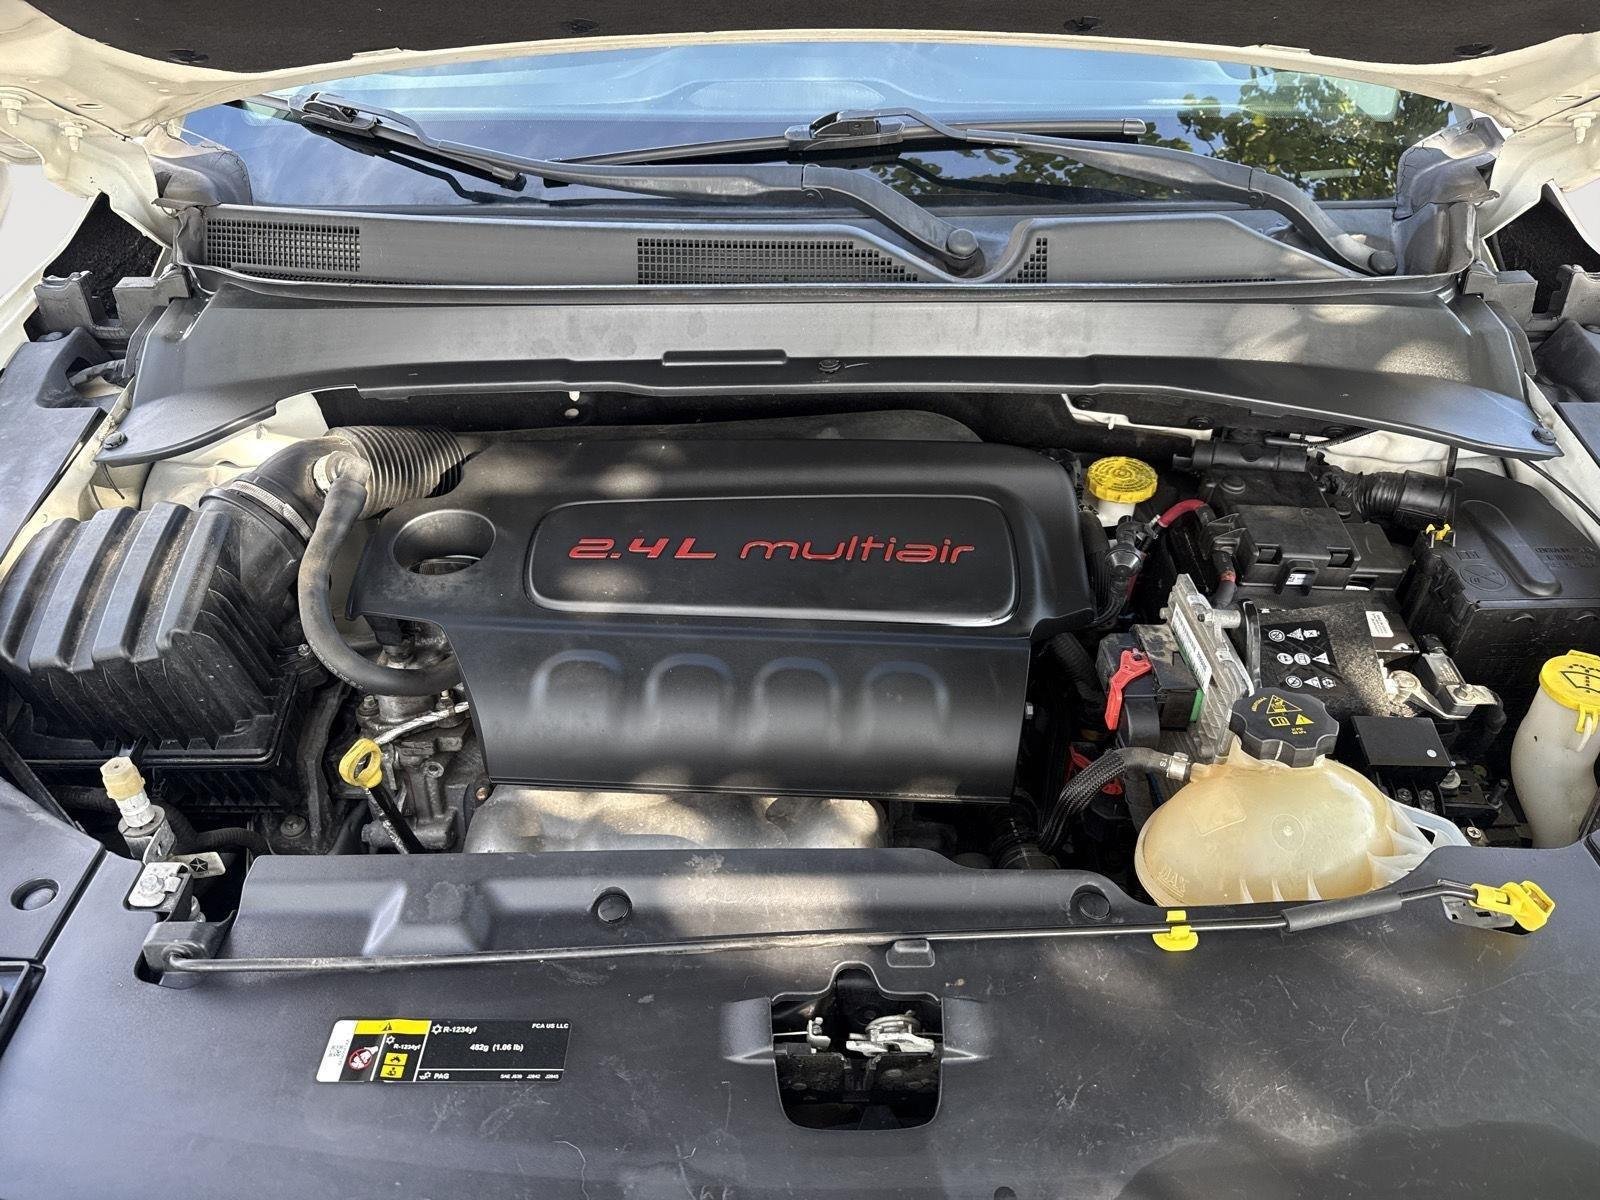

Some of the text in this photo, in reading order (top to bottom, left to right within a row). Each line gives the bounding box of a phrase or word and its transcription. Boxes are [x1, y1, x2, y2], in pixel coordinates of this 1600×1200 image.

[739, 535, 976, 564] multiair
[443, 1025, 478, 1035] R-1234yf
[513, 1043, 524, 1052] lb)
